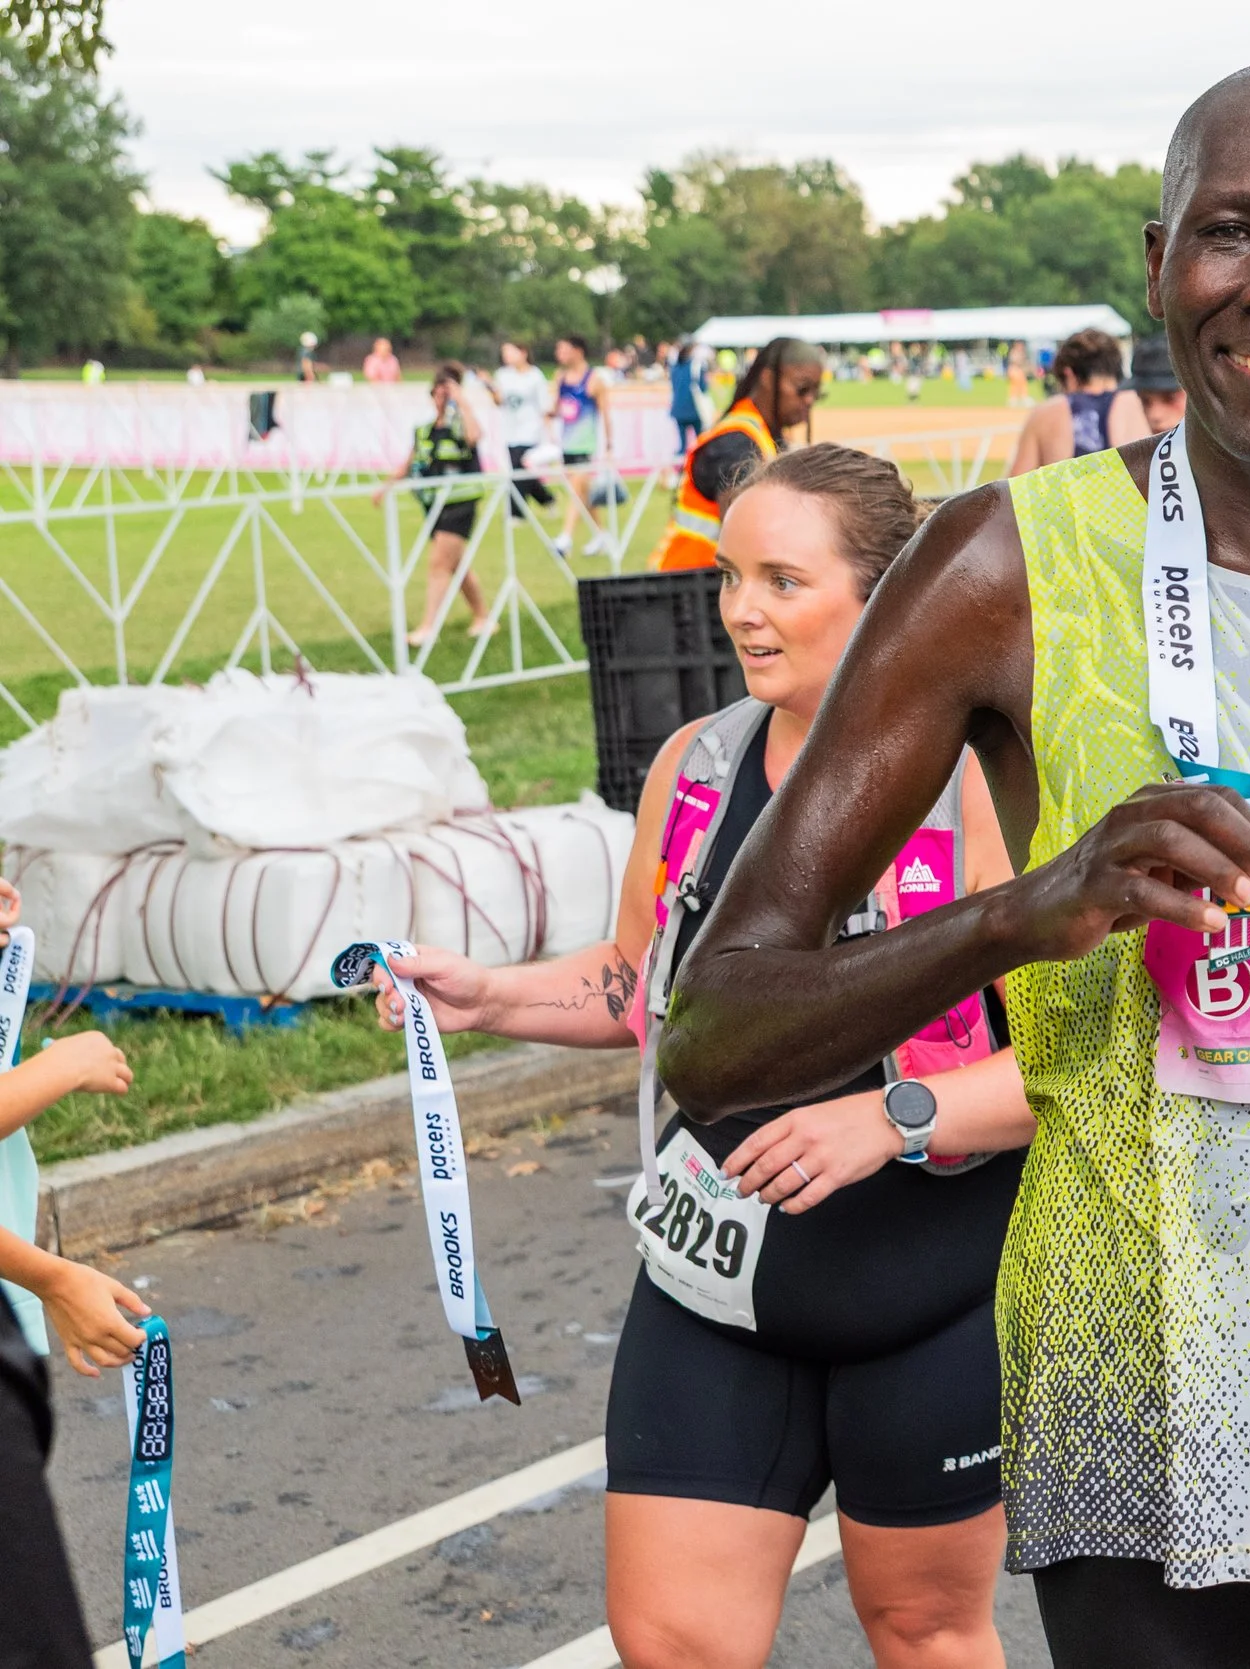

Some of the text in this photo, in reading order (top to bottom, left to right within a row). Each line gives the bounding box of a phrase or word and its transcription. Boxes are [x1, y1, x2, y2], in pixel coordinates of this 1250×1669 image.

[1153, 578, 1166, 660] RUNNING
[1161, 565, 1195, 671] pacers
[3, 944, 22, 995] pacers
[1215, 957, 1230, 968] DC
[407, 992, 438, 1081] BROOKS
[1196, 1050, 1235, 1063] GEAR
[425, 1112, 452, 1180] pacers
[440, 1211, 465, 1300] BROOKS
